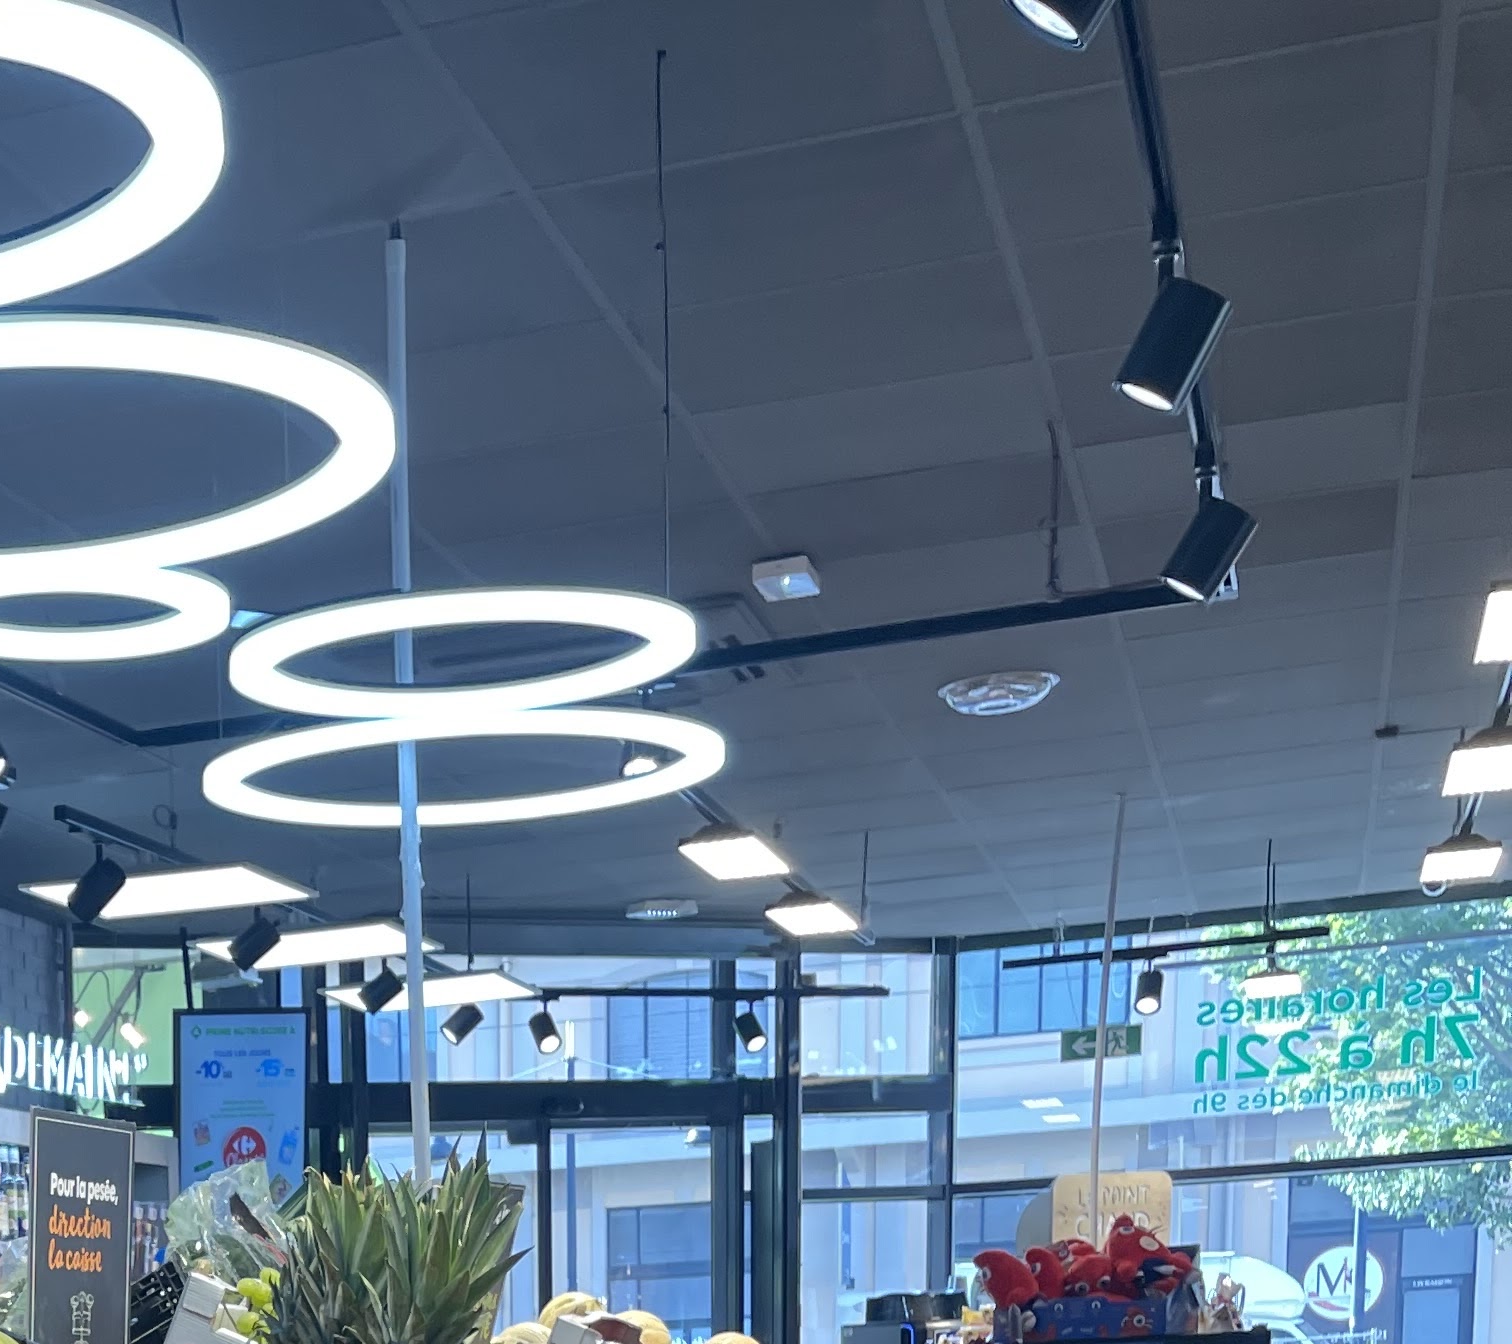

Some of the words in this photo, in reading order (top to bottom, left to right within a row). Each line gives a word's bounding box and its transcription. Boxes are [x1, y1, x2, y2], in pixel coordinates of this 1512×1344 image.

[50, 1172, 75, 1198] Pour
[76, 1175, 87, 1199] la
[87, 1179, 119, 1206] pesée,
[49, 1203, 111, 1240] direction
[48, 1237, 65, 1270] la
[66, 1247, 103, 1273] caisse
